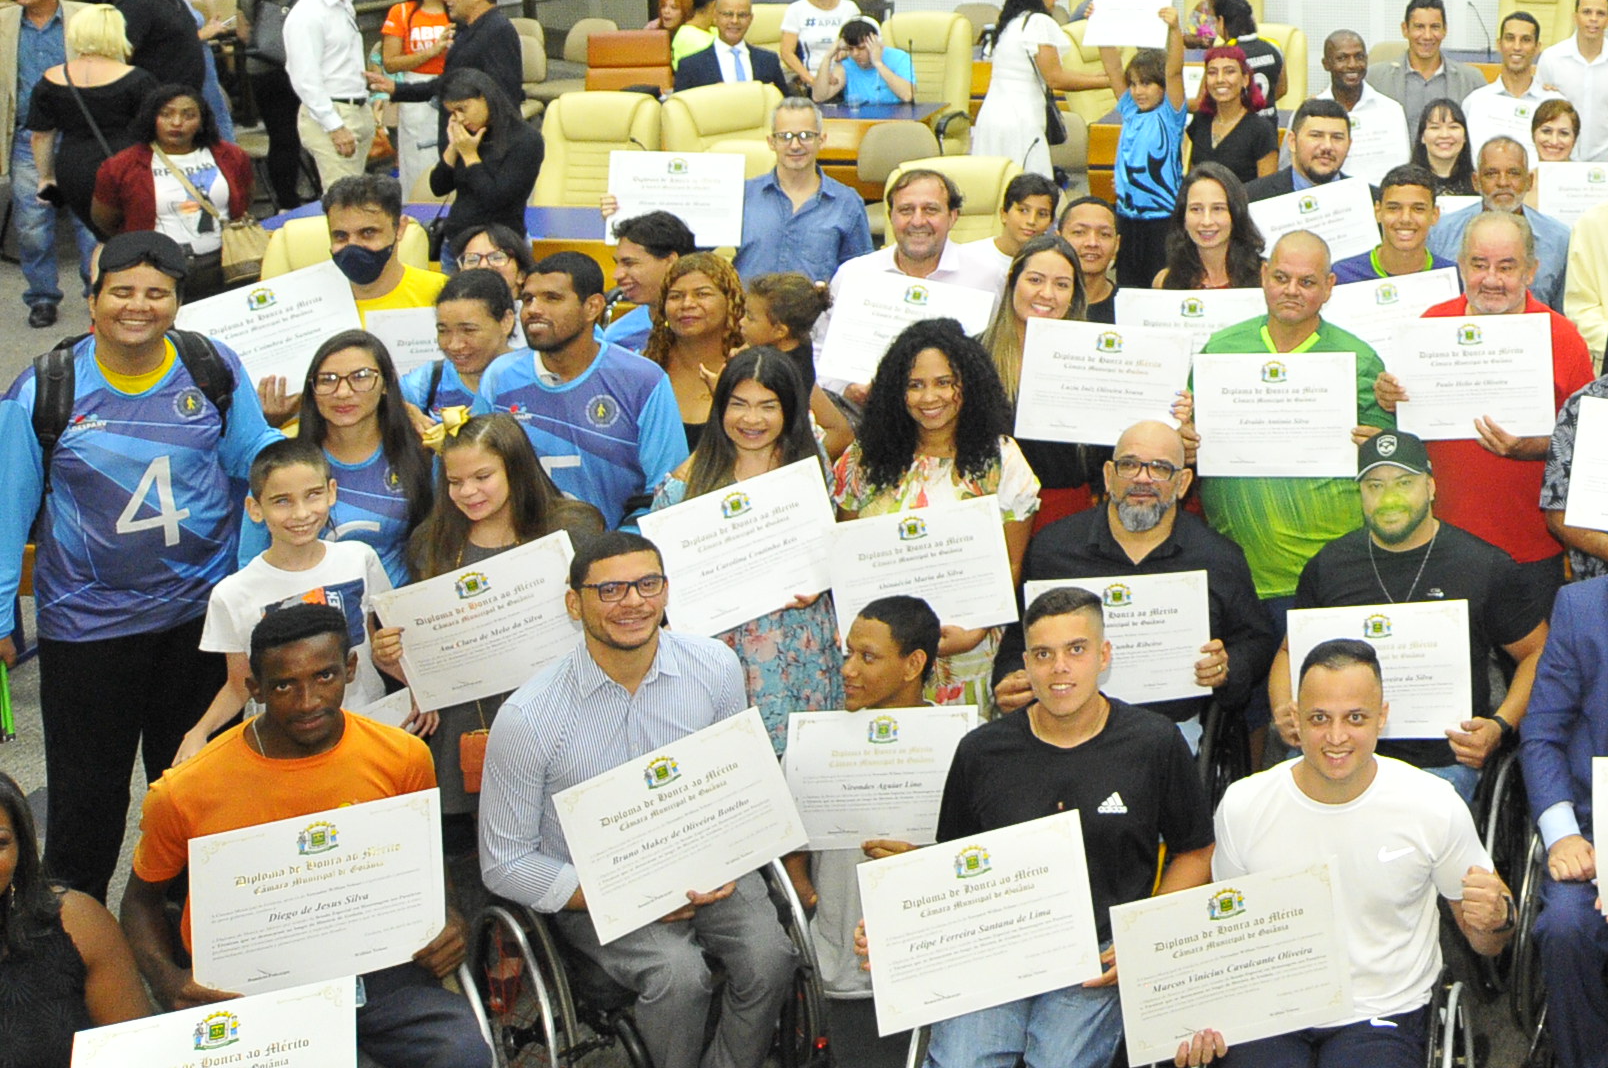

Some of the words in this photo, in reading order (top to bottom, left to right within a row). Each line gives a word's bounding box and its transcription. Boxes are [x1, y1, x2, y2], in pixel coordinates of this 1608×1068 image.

[116, 455, 190, 547] 4
[440, 644, 454, 652] Ana
[454, 638, 478, 648] Clara
[490, 626, 510, 636] Melo
[524, 614, 542, 624] Silva
[600, 804, 642, 828] Diploma
[644, 800, 654, 808] de
[658, 784, 688, 802] Honra
[692, 778, 702, 787] ao
[706, 762, 738, 781] Mérito
[1097, 805, 1128, 814] adidas
[612, 850, 639, 865] Bruno
[642, 836, 668, 850] Makey
[670, 830, 680, 839] de
[682, 814, 716, 834] Oliveira
[718, 798, 750, 817] Botelho
[268, 910, 297, 922] Diego
[300, 906, 312, 915] de
[314, 900, 342, 911] Jesus
[344, 894, 368, 904] Silva
[902, 892, 946, 910] Diploma
[964, 880, 996, 894] Honra
[1000, 876, 1011, 884] ao
[1014, 866, 1048, 882] Mérito
[954, 894, 992, 910] Municipal
[910, 940, 936, 952] Felipe
[940, 930, 975, 944] Ferreira
[978, 920, 1014, 933] Santana
[1016, 914, 1026, 923] de
[1028, 910, 1051, 920] Lima
[1154, 934, 1200, 952] Diploma
[1202, 930, 1212, 939] de
[1218, 920, 1249, 934] Honra
[1252, 918, 1265, 926] ao
[1268, 908, 1304, 923] Mérito
[1172, 946, 1203, 959] Câmara
[1206, 934, 1245, 951] Municipal
[1248, 932, 1255, 940] de
[1154, 980, 1185, 992] Marcos
[1226, 956, 1276, 974] Cavalcante
[1278, 948, 1312, 960] Oliveira
[200, 1054, 241, 1067] Honra
[246, 1050, 260, 1058] ao
[266, 1038, 310, 1056] Mérito
